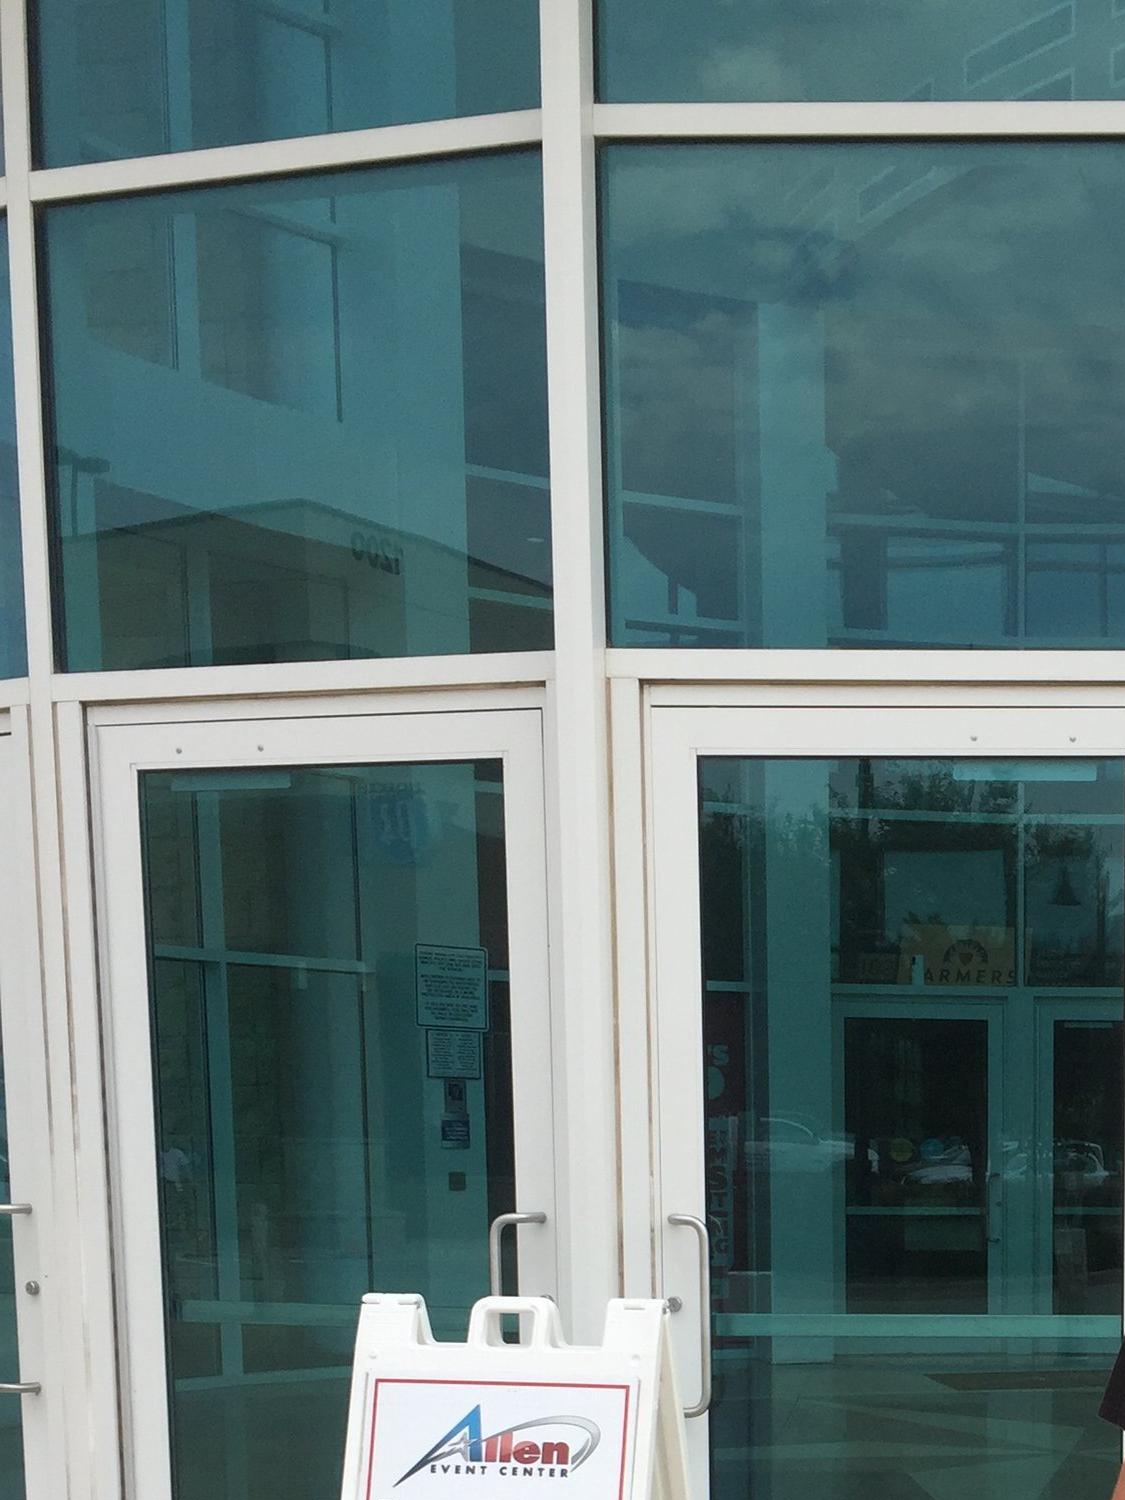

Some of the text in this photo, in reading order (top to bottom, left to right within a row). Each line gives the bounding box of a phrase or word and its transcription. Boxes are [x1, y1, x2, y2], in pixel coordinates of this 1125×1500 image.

[924, 969, 1017, 985] ARMERS
[393, 1404, 569, 1488] Allen
[430, 1464, 569, 1478] EVENT CENTER
